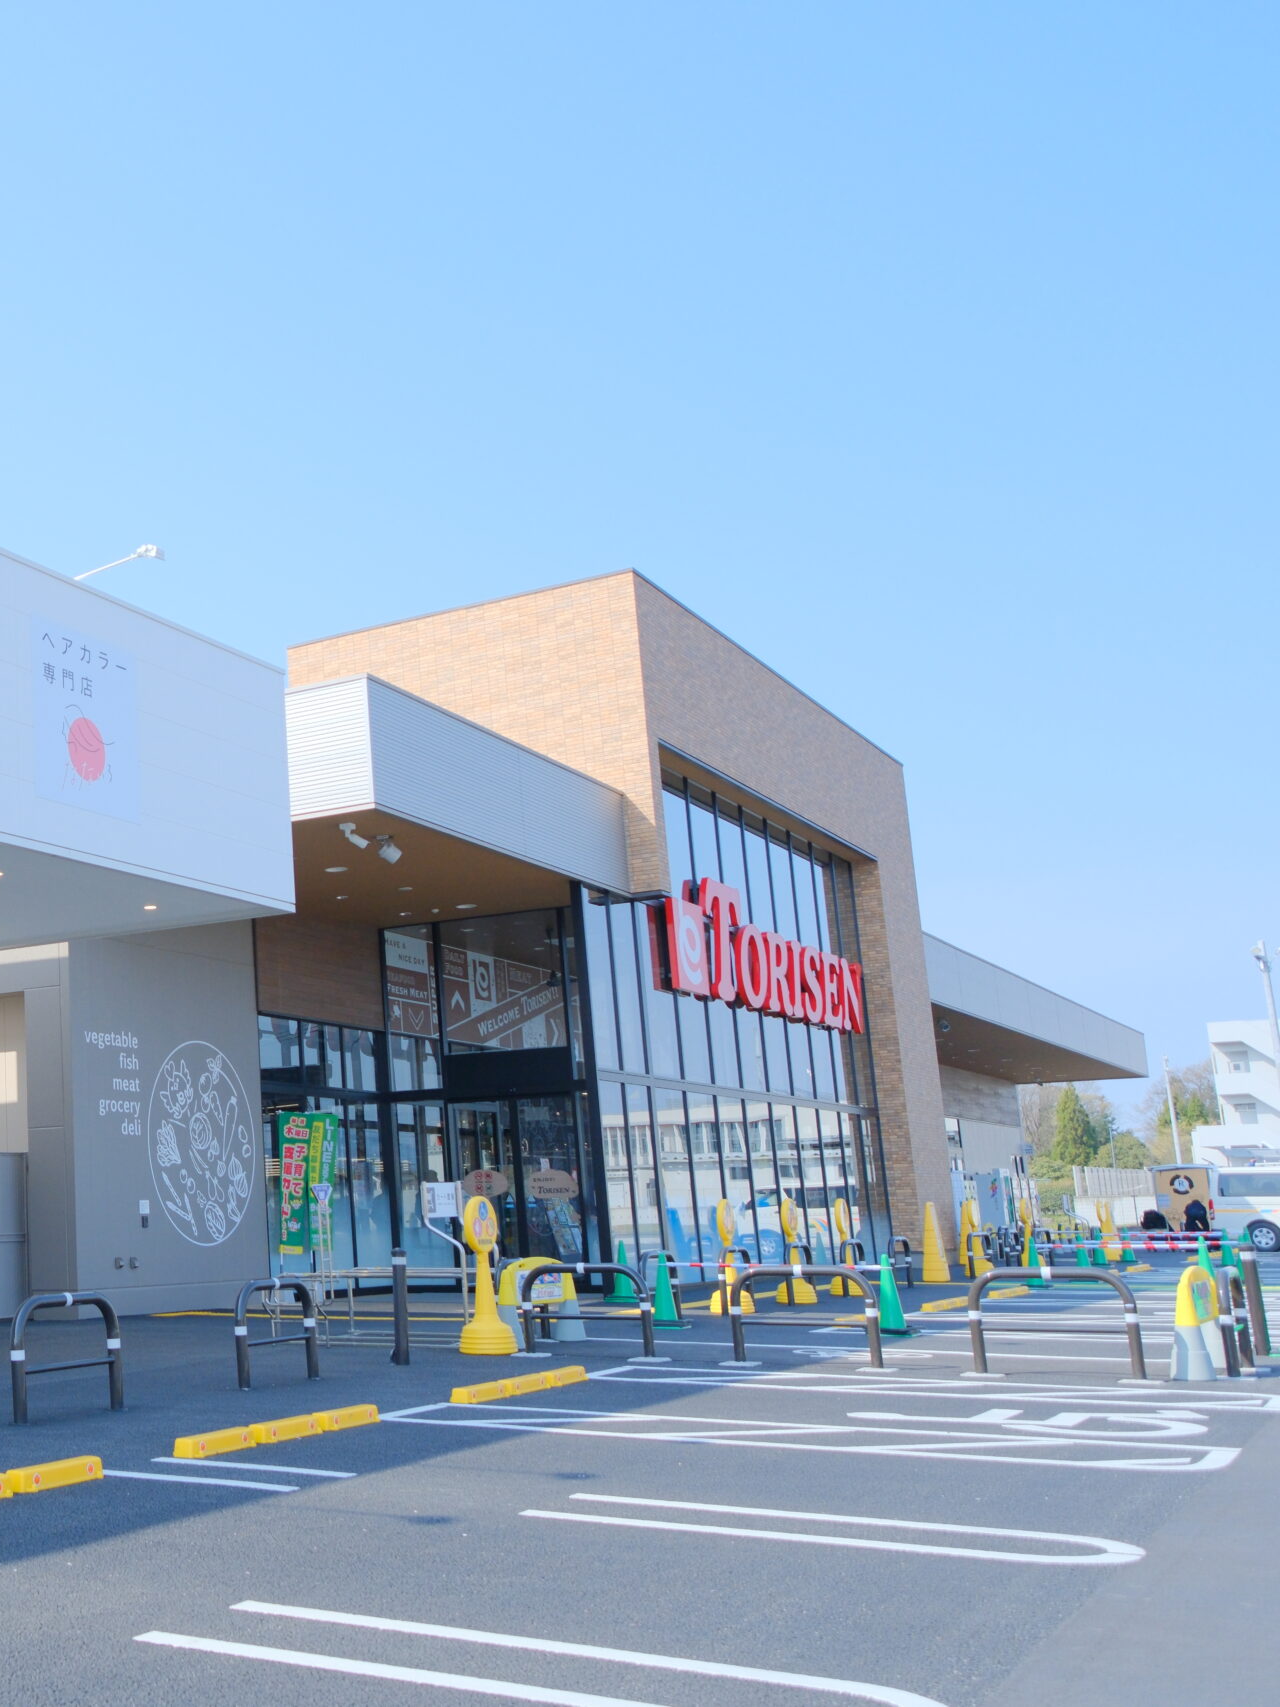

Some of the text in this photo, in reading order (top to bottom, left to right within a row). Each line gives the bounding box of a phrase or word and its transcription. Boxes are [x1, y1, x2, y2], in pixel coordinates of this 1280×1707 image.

[42, 632, 127, 671] ヘアカラー
[42, 661, 93, 698] 専門店
[398, 954, 413, 964] NICE
[699, 877, 865, 1034] TORISEN
[387, 983, 428, 1000] FRESH MEAT
[477, 1007, 521, 1037] WELCOME
[84, 1030, 138, 1049] vegetable
[119, 1052, 139, 1070] fish
[112, 1077, 140, 1092] meat
[99, 1099, 141, 1117] grocery
[121, 1119, 142, 1136] deli
[293, 1143, 306, 1196] 子育て
